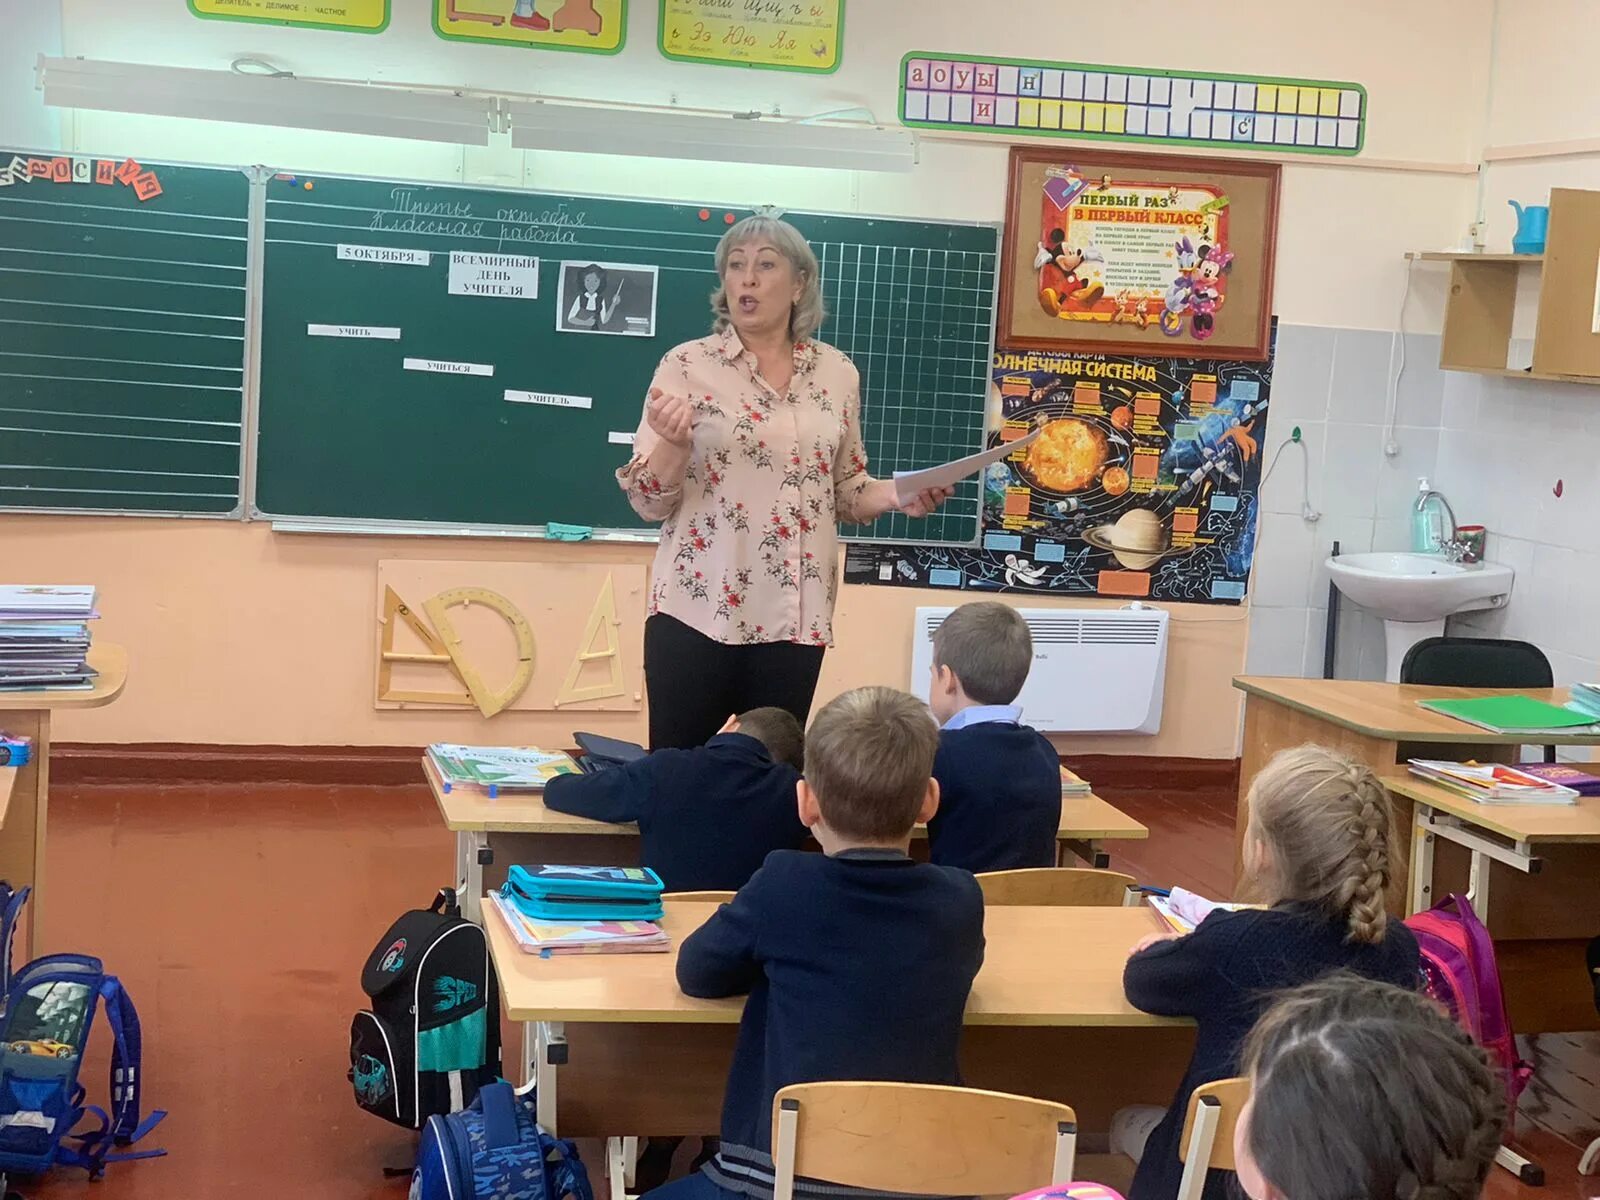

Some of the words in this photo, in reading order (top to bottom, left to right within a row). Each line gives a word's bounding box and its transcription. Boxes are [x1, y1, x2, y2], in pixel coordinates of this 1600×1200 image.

[265, 2, 300, 11] ДЕЛИМОЕ
[315, 7, 347, 16] ЧАСТНОЕ
[689, 22, 712, 42] Ээ
[722, 25, 757, 47] Юю
[769, 30, 797, 50] Яя
[912, 67, 924, 82] а
[934, 68, 946, 83] о
[956, 70, 970, 89] у
[977, 72, 995, 87] ы
[976, 103, 991, 117] и
[391, 187, 473, 220] Третье
[496, 203, 586, 227] октября
[1080, 194, 1139, 207] ПЕРВЫЙ
[1144, 196, 1169, 208] РАЗ
[1074, 208, 1084, 220] В
[1088, 209, 1150, 223] ПЕРВЫЙ
[1155, 212, 1203, 225] КЛАСС
[497, 223, 578, 252] работа
[344, 248, 351, 257] 5
[354, 248, 416, 263] ОКТЯБРЯ
[453, 254, 536, 269] ВСЕМИРНЫЙ
[476, 270, 511, 281] ДЕНЬ
[463, 283, 523, 296] УЧИТЕЛЯ
[338, 327, 371, 336] УЧИТЬ
[427, 361, 471, 373] УЧИТЬСЯ
[992, 353, 1081, 376] ОЛНЕЧНАЯ
[1086, 361, 1157, 382] СИСТЕМА
[527, 393, 571, 405] УЧИТЕЛЬ
